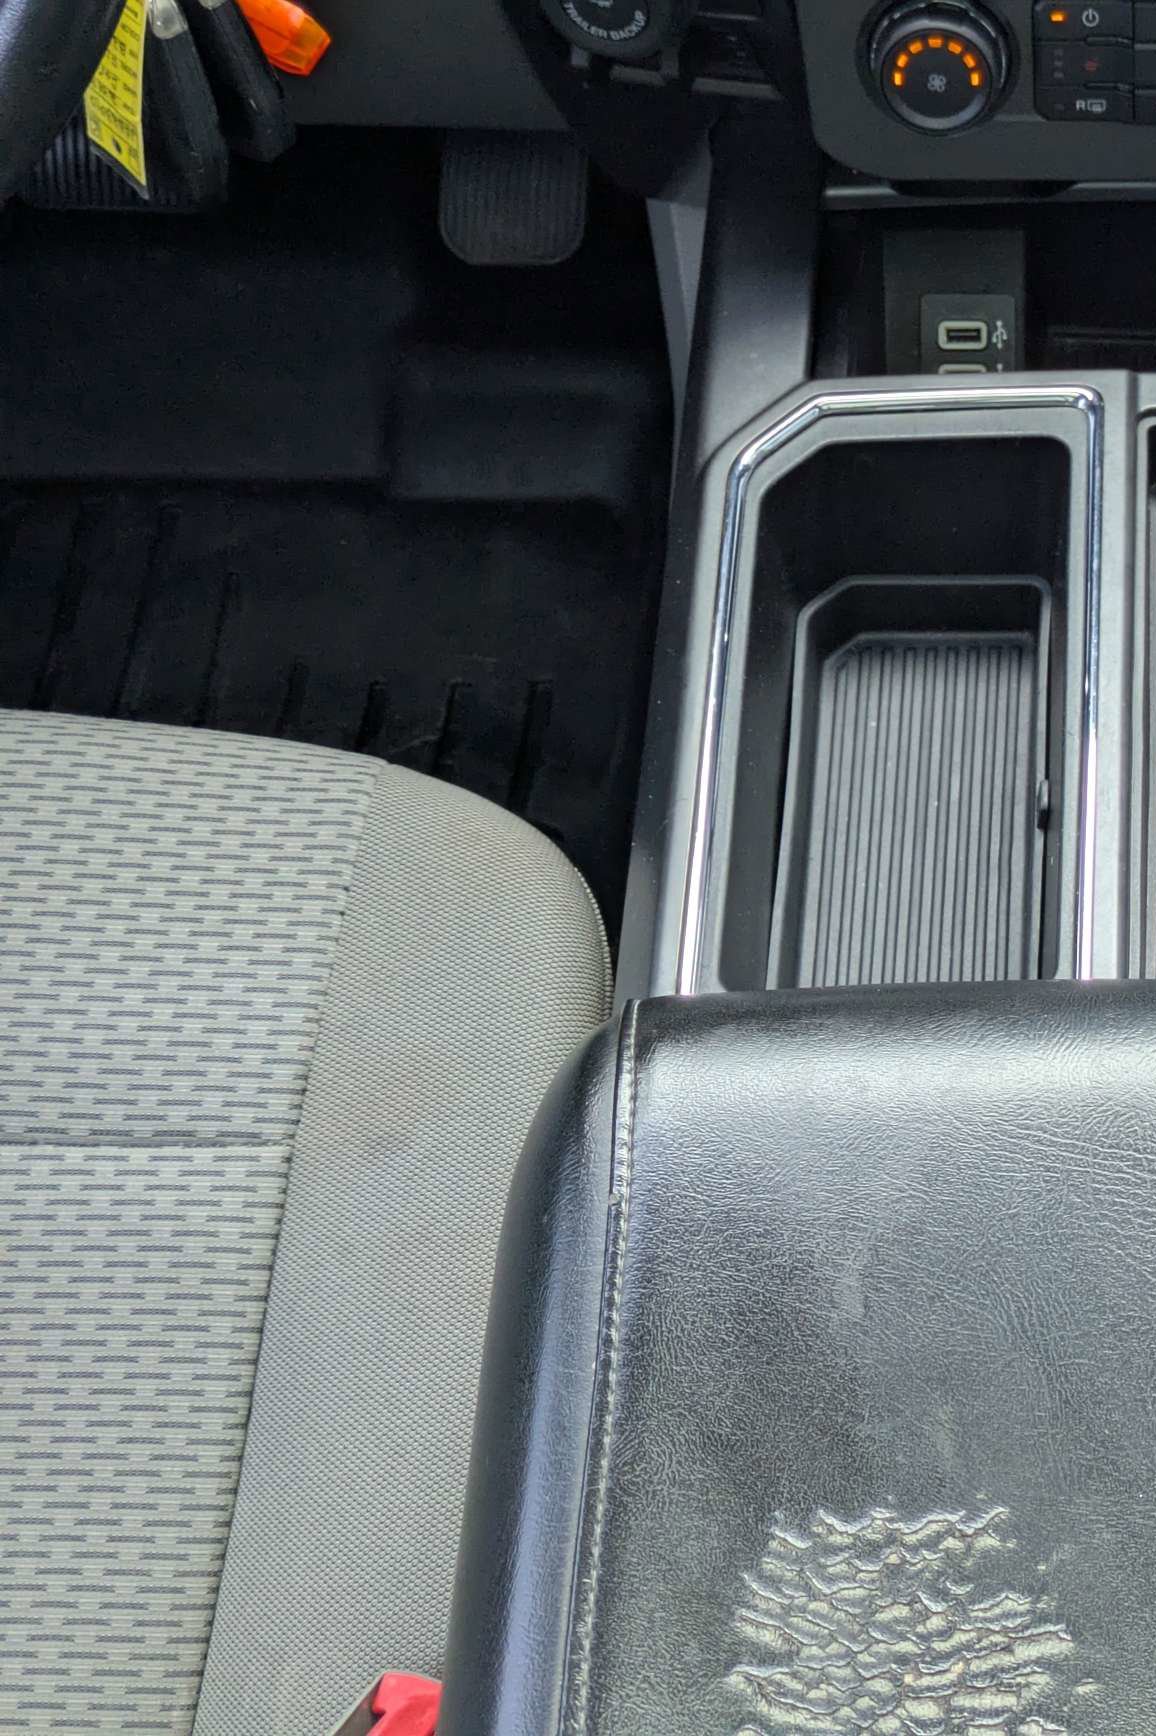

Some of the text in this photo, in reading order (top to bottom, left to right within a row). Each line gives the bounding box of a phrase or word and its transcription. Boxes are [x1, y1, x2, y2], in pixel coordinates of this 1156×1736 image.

[564, 2, 647, 41] TRAILER BACKUP
[1076, 100, 1086, 110] R
